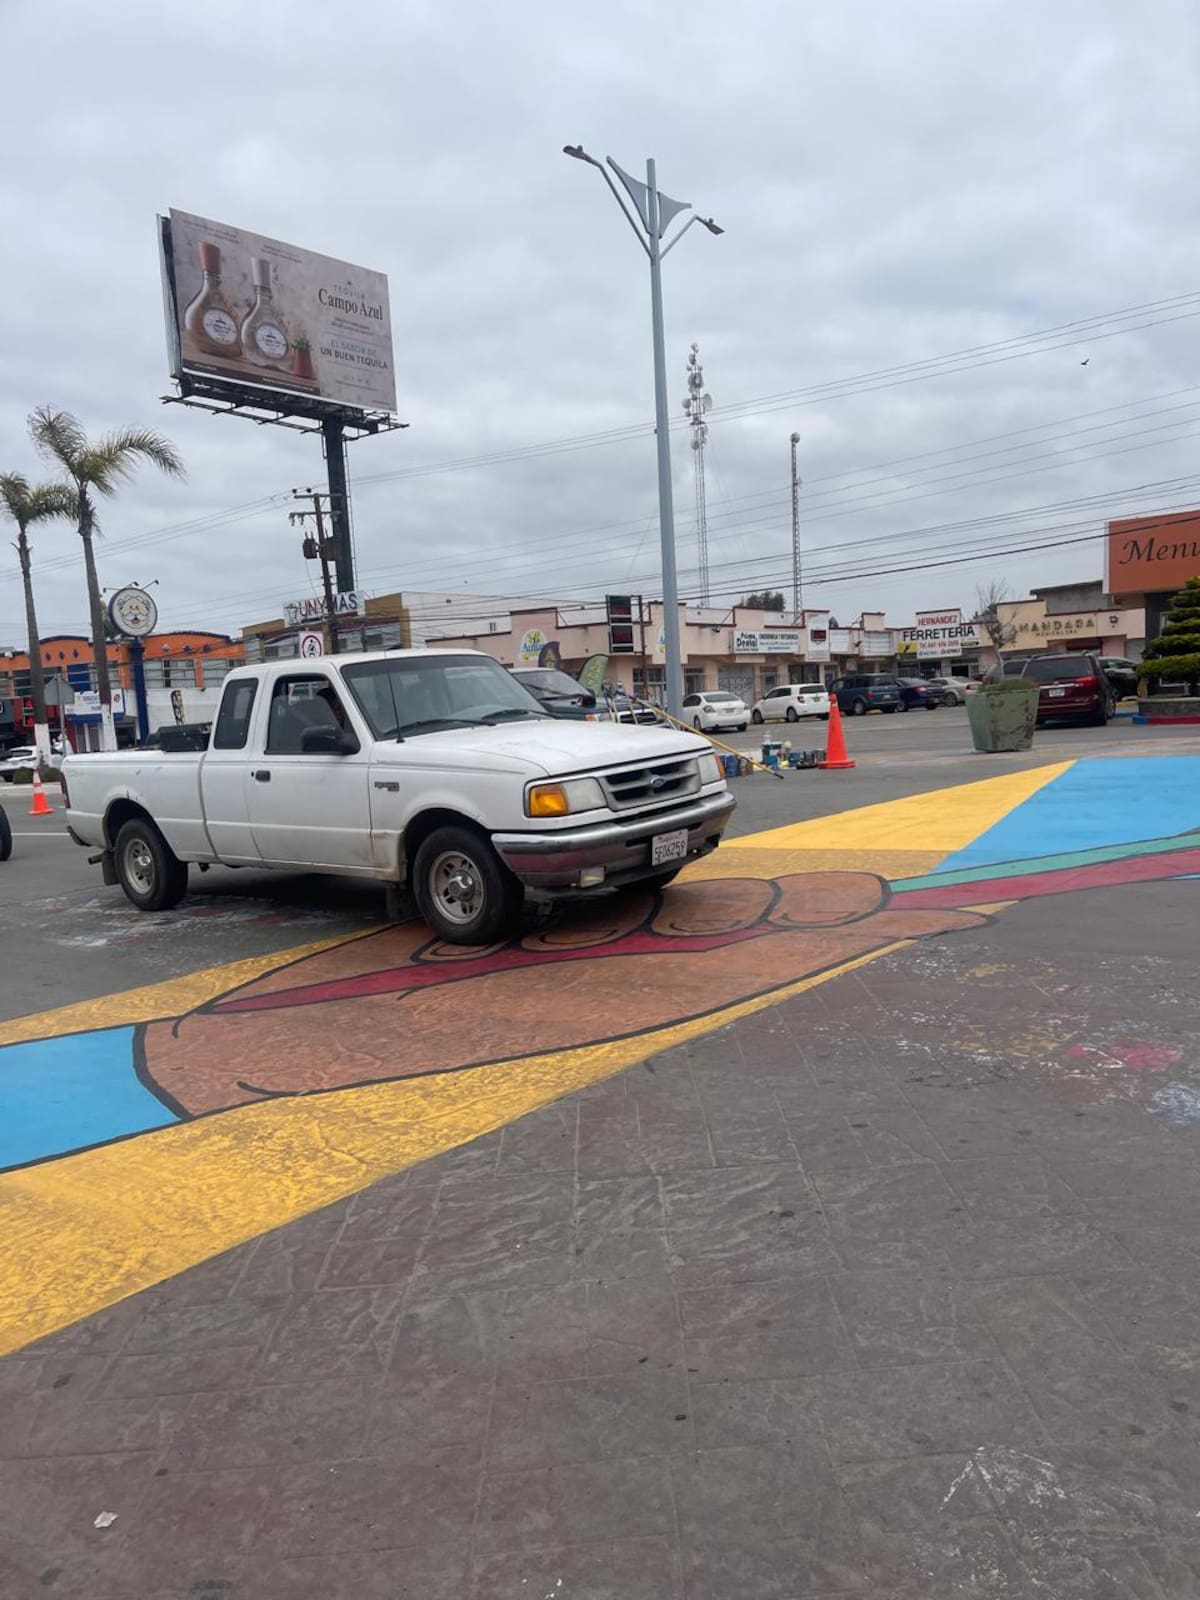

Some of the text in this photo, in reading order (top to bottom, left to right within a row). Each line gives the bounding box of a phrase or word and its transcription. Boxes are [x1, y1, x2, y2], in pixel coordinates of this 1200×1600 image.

[318, 288, 383, 320] Campo Azul
[320, 346, 388, 369] UN BUEN TEQUILA
[918, 614, 958, 627] HERNANDEZ
[903, 625, 976, 641] FERRETERIA
